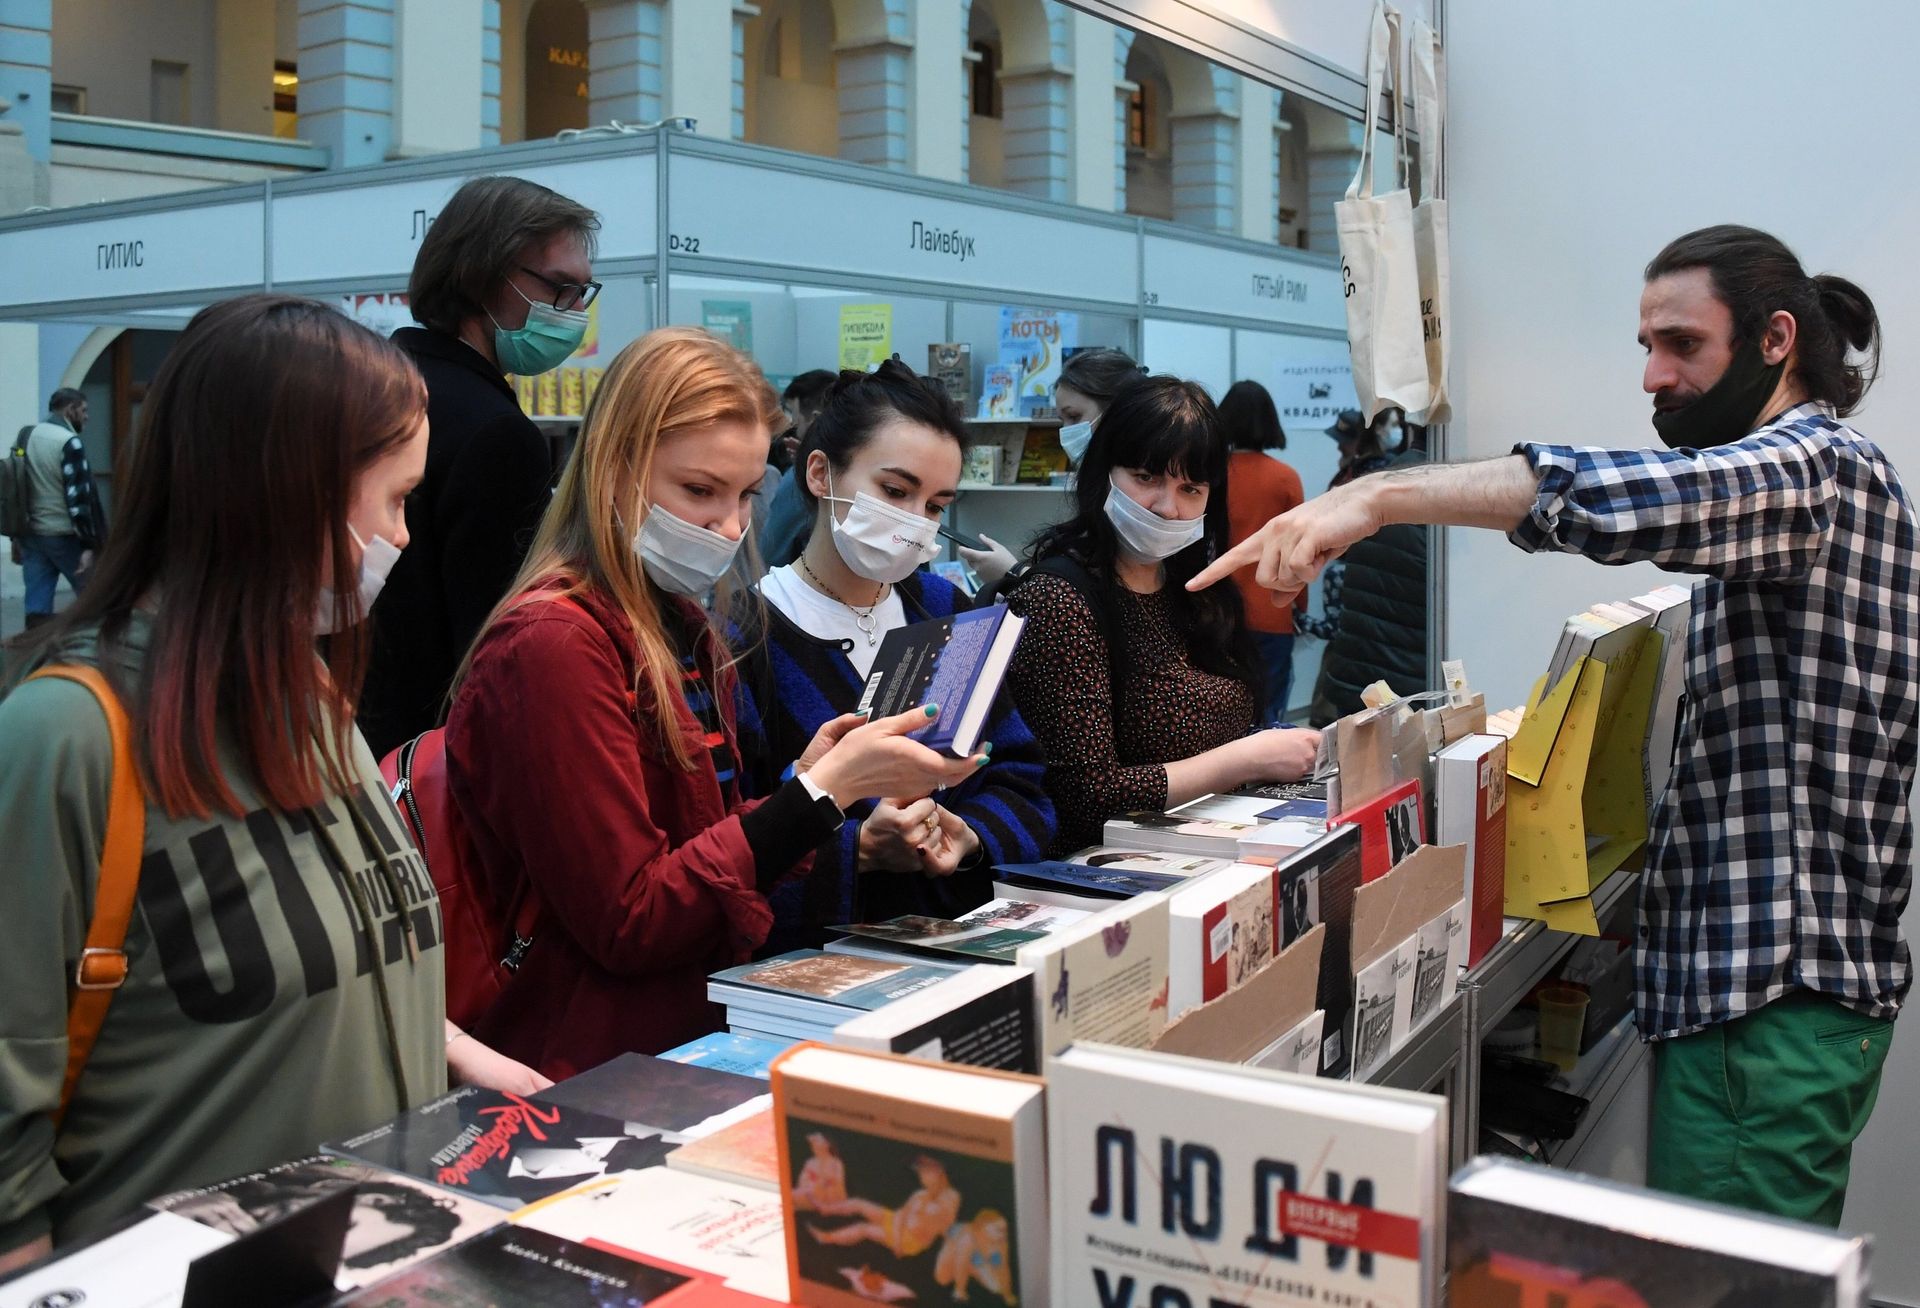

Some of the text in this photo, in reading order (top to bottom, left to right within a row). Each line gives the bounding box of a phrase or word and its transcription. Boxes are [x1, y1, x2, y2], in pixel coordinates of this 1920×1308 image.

[411, 210, 437, 240] Л
[97, 240, 144, 270] ГИТИС
[670, 234, 700, 253] D-22
[910, 220, 976, 262] Лайвбук
[1011, 320, 1060, 344] КОТЫ
[1090, 1123, 1377, 1280] ЛЮДИ
